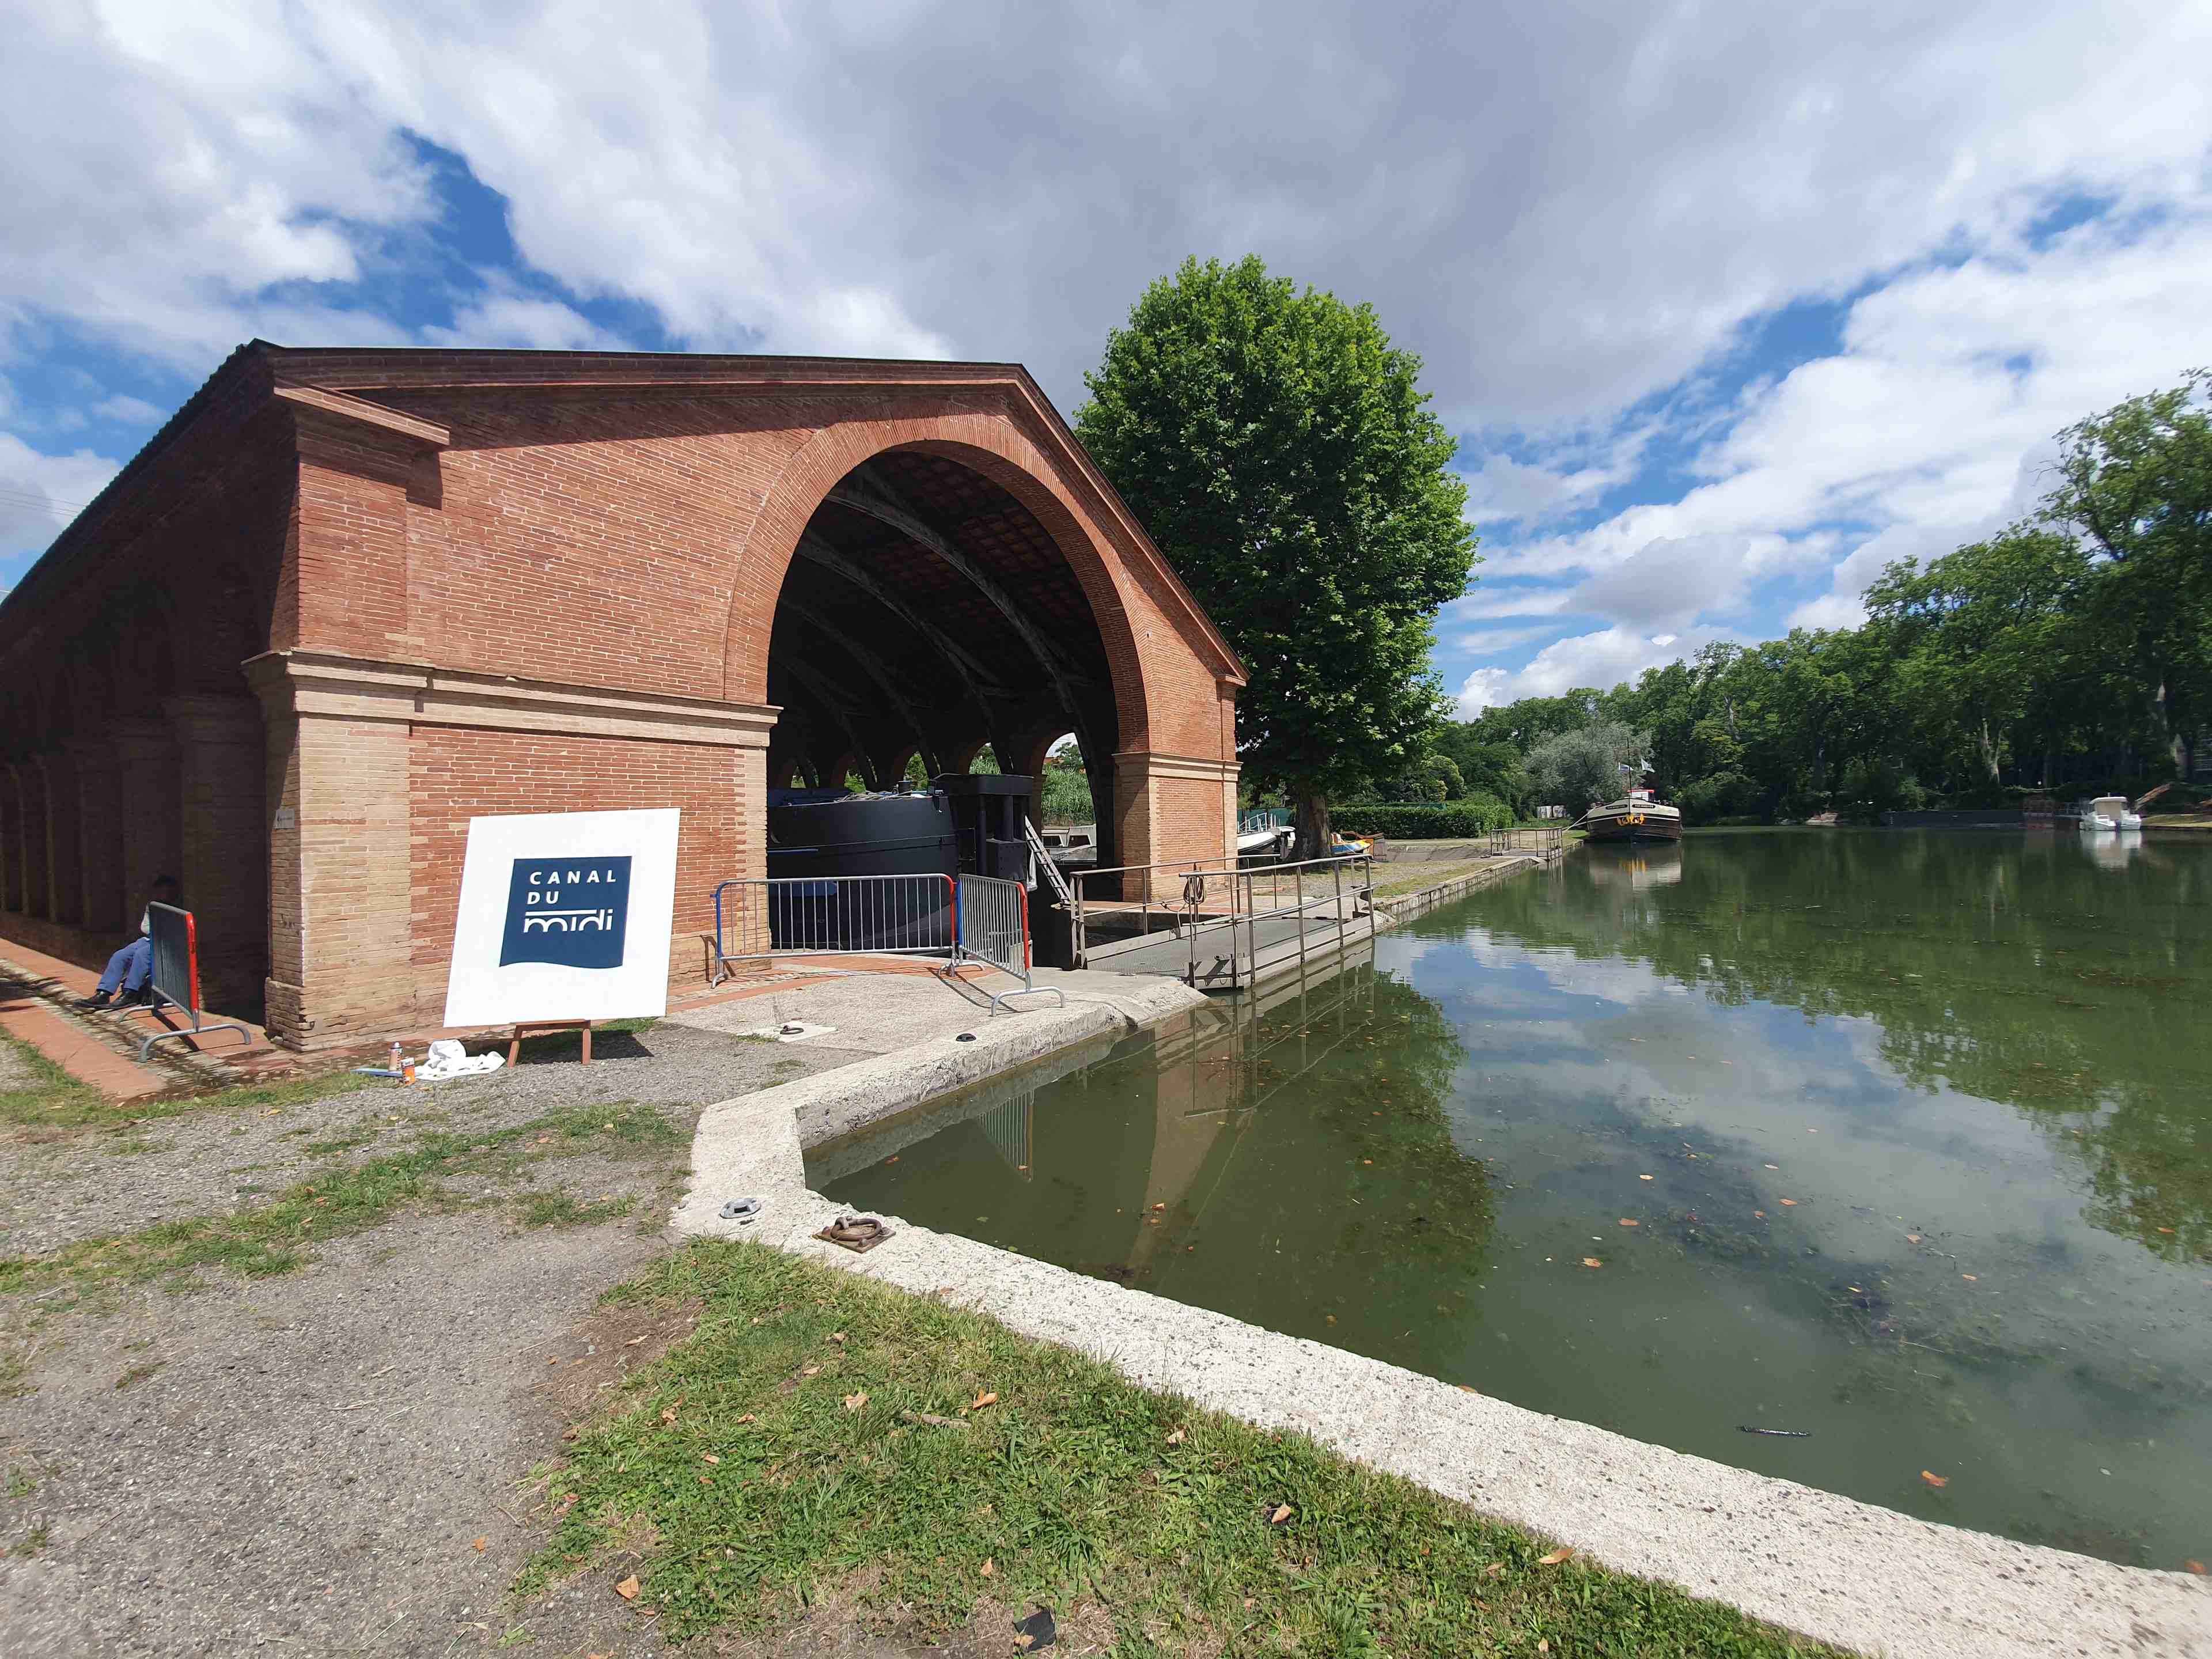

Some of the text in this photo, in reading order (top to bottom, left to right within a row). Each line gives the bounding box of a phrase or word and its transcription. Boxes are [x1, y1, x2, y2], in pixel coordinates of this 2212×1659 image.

[529, 869, 616, 885] CANAL
[527, 891, 559, 905] DU
[523, 908, 613, 933] midi
